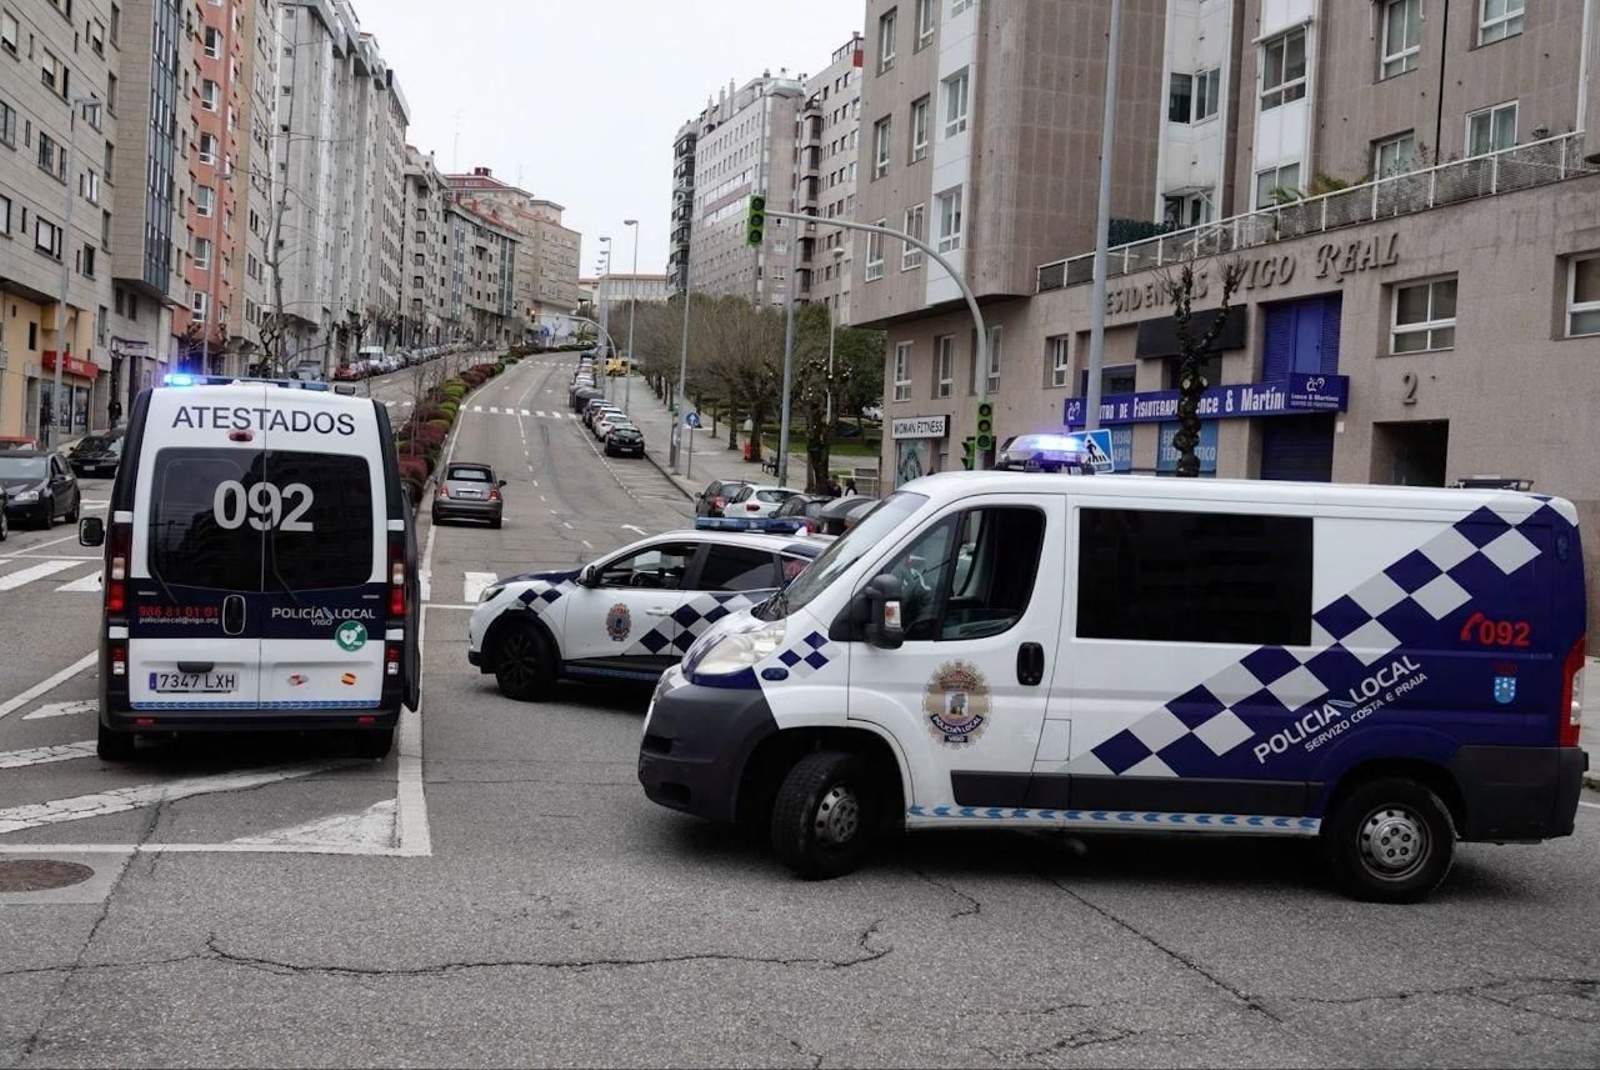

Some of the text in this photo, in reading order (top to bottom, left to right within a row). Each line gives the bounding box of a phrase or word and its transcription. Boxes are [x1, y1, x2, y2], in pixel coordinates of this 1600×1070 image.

[1229, 255, 1297, 293] VIGO
[1315, 232, 1399, 283] REAL
[1120, 403, 1128, 419] DE
[1133, 397, 1178, 419] FISIOTERAPI
[1225, 389, 1234, 412] &
[1240, 386, 1286, 412] Martín
[1401, 371, 1419, 408] 2
[172, 406, 355, 436] ATESTADOS
[894, 420, 943, 434] WOMAN FITNESS
[213, 480, 314, 532] 092
[271, 606, 376, 619] POLICÍA LOCAL
[1480, 620, 1531, 646] 092
[160, 674, 235, 688] 7347 LXH
[1348, 655, 1421, 704] LOCAL
[961, 717, 982, 733] LOCAL
[1304, 719, 1350, 752] SERVIZO
[1350, 699, 1385, 723] COSTA
[1394, 672, 1428, 697] PRAIA
